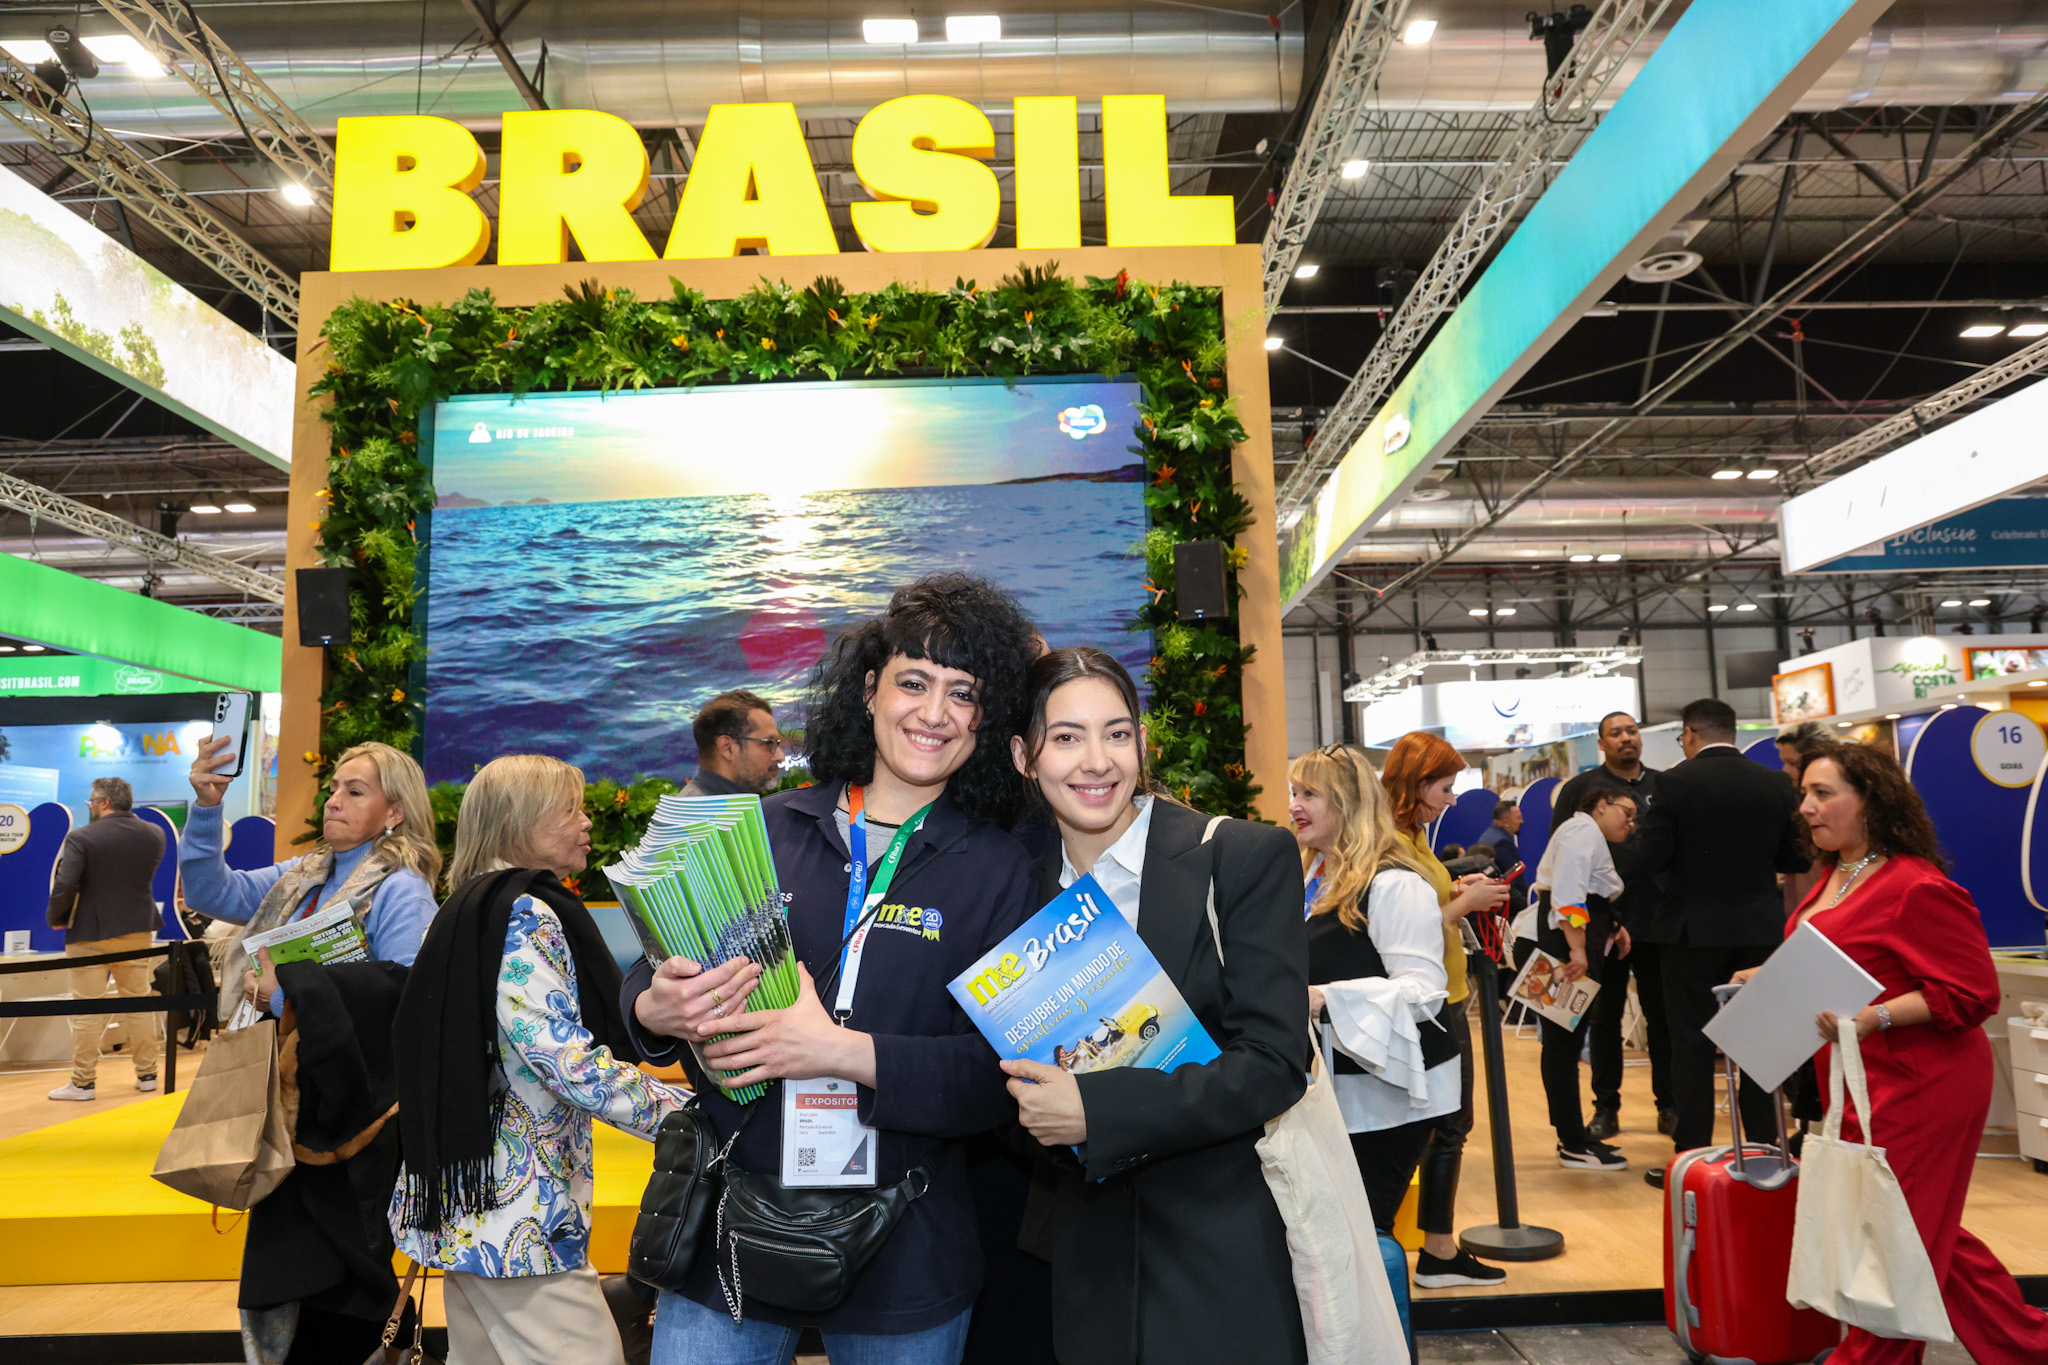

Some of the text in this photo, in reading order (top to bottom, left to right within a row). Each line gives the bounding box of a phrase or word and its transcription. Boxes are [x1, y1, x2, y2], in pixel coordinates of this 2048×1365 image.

[330, 93, 1236, 272] BRASIL
[1895, 546, 1977, 556] COLLECTION
[126, 676, 153, 685] BRASIL
[1912, 673, 1957, 687] COSTA
[1998, 726, 2023, 744] 16
[0, 815, 14, 827] 20
[877, 904, 923, 926] m&e
[925, 911, 938, 922] 20
[310, 926, 355, 948] LOS DESTINOS
[312, 928, 337, 941] BELLOS
[332, 934, 358, 950] ACTIVAS
[320, 941, 361, 960] PROPUESTAS
[966, 893, 1102, 1007] m&e Brasil
[1004, 996, 1061, 1046] DESCUBRE
[1056, 982, 1076, 1004] UN
[1070, 952, 1111, 991] MUNDO
[1106, 940, 1126, 960] DE
[1016, 1005, 1073, 1054] aventuras
[1075, 996, 1088, 1014] y
[1086, 953, 1132, 996] encantos
